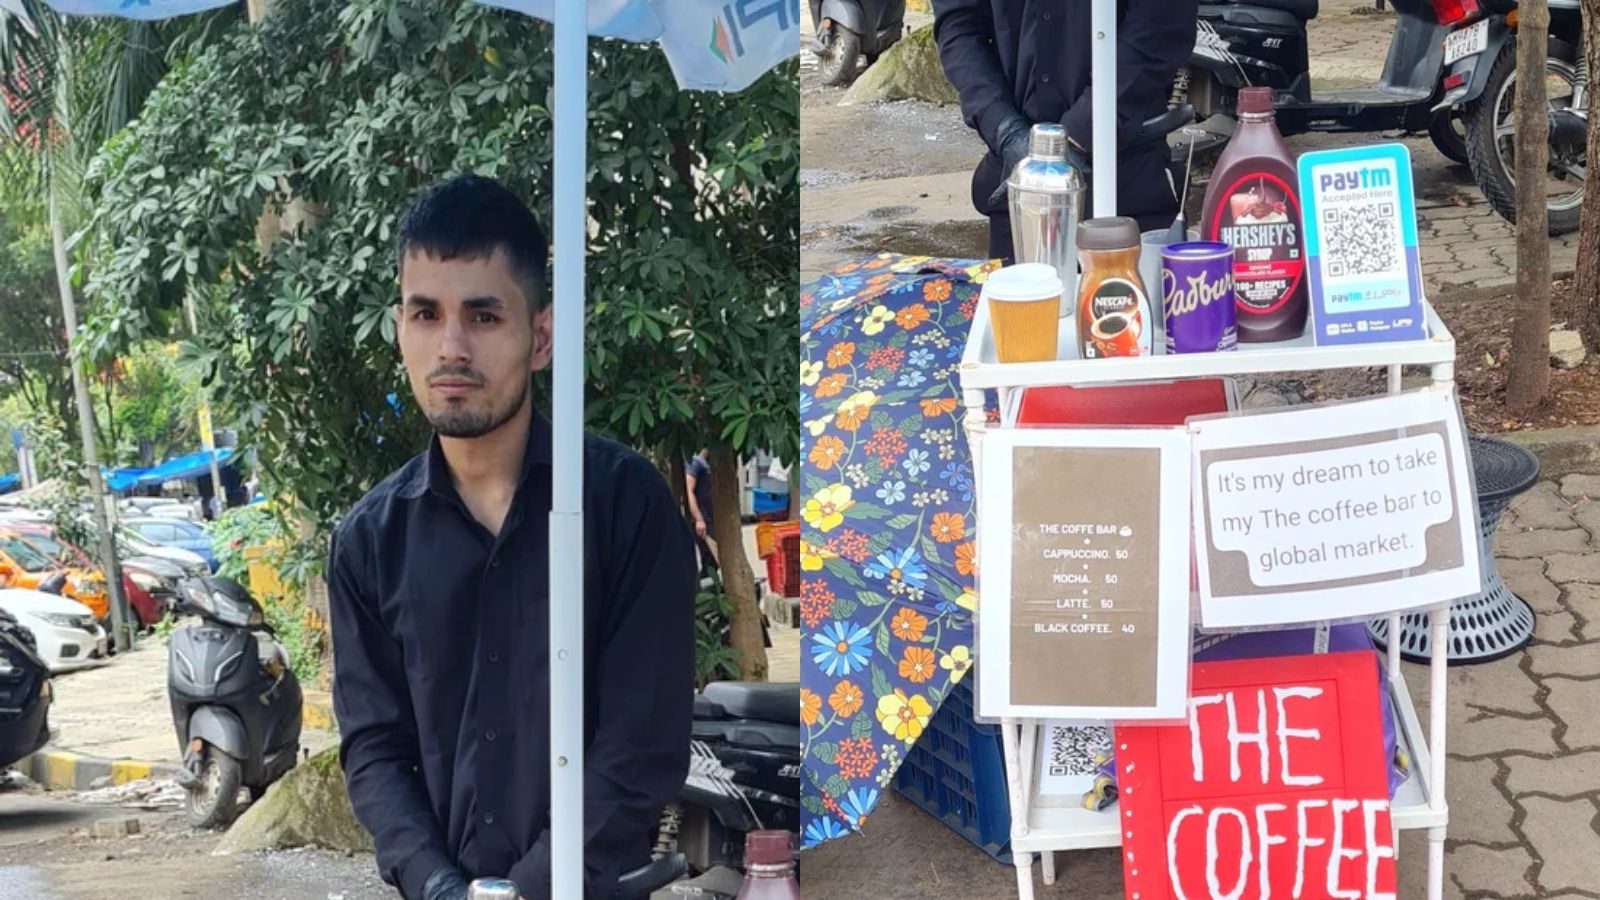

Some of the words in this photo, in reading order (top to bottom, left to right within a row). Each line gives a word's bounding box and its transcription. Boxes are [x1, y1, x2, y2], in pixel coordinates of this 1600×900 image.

[1322, 191, 1367, 203] Accepted
[1369, 190, 1393, 199] Here
[1221, 223, 1296, 248] HERSHEY'S
[1247, 247, 1273, 261] SYRUP
[1218, 472, 1246, 493] It's
[1252, 472, 1285, 493] my
[1292, 464, 1363, 487] dream
[1368, 458, 1390, 476] to
[1396, 448, 1438, 471] take
[1222, 514, 1253, 536] my
[1260, 508, 1301, 529] The
[1308, 499, 1379, 525] coffee
[1384, 494, 1417, 514] bar
[1422, 489, 1442, 507] to
[1040, 524, 1059, 535] THE
[1061, 524, 1094, 535] COFFE
[1096, 524, 1117, 535] BAR
[1043, 549, 1111, 559] CAPPUCCINO.
[1115, 549, 1128, 559] 50
[1259, 541, 1328, 573] global
[1334, 532, 1415, 560] market.
[1052, 574, 1092, 584] MOCHA.
[1105, 574, 1118, 584] 50
[1056, 598, 1092, 609] LATTE.
[1101, 599, 1113, 609] 50
[1034, 623, 1068, 633] BLACK
[1070, 623, 1112, 633] COFFEE.
[1122, 623, 1135, 633] 40
[1189, 686, 1324, 786] THE
[1167, 798, 1397, 900] COFFEE
